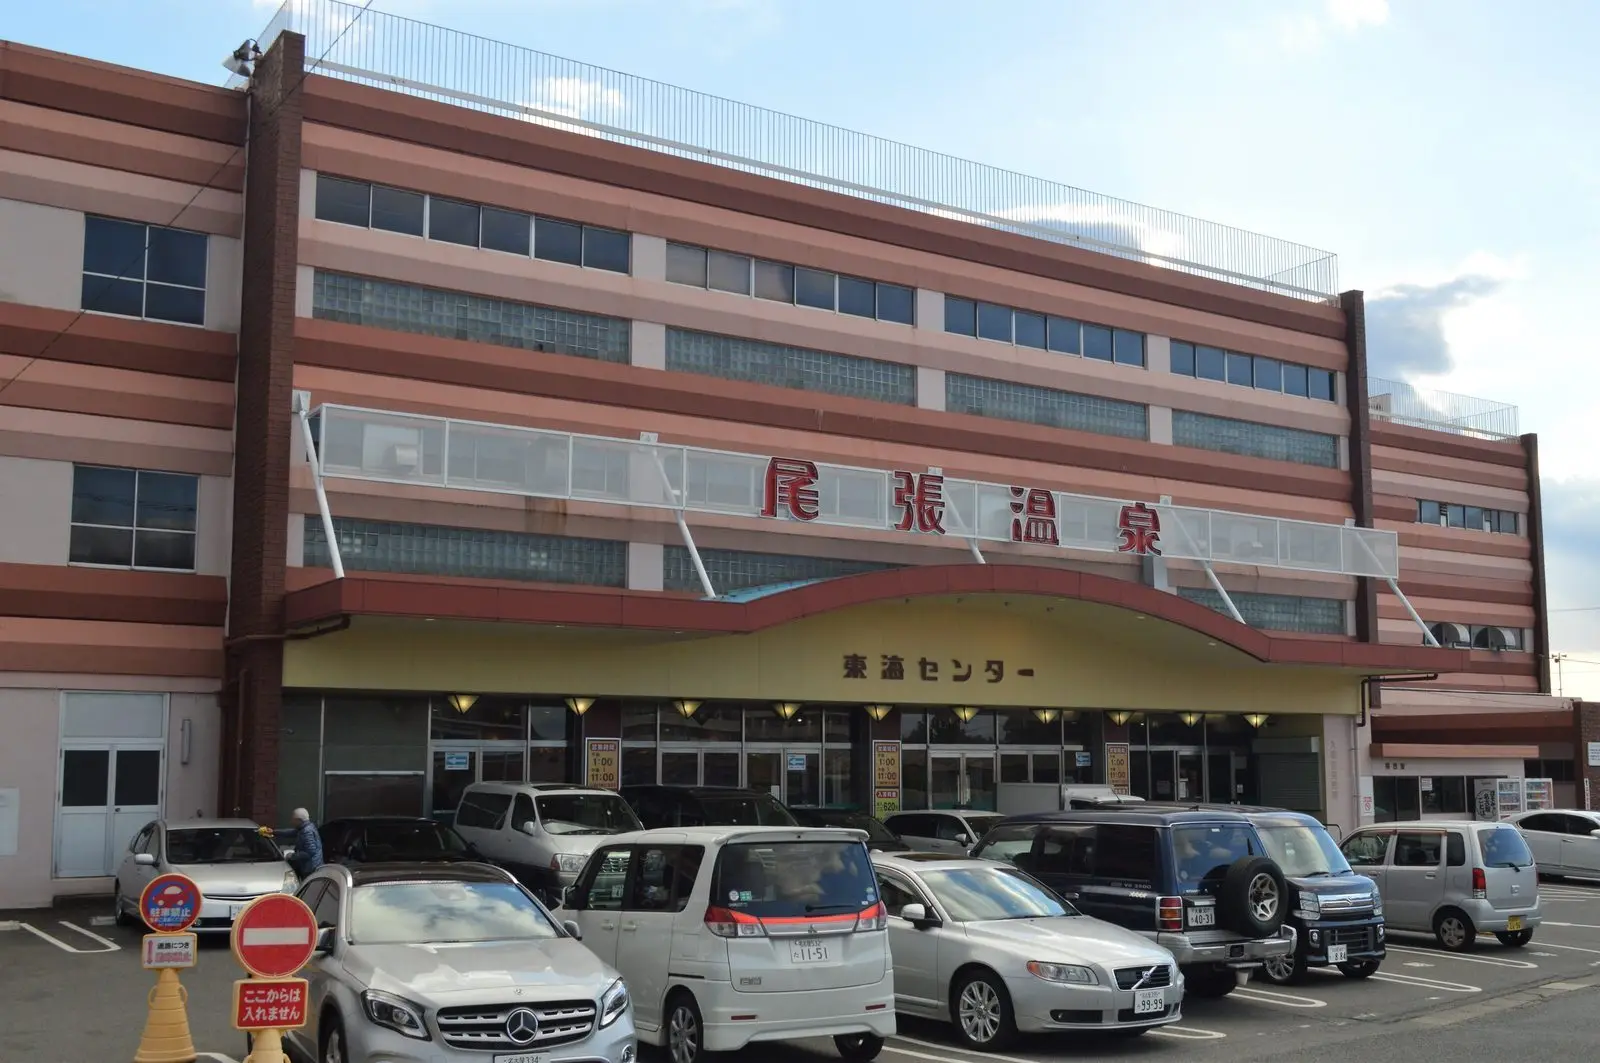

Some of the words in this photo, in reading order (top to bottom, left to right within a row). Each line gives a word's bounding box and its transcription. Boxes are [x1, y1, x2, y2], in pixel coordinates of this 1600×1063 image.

[760, 456, 1162, 557] 尾張温泉
[843, 653, 1035, 683] 東海センター
[593, 758, 612, 766] 1:00
[880, 758, 895, 766] 1:00
[592, 773, 614, 781] 11:00
[878, 772, 896, 780] 11:00
[244, 988, 301, 1003] ここからは
[1141, 998, 1163, 1011] 99-99
[242, 1006, 300, 1021] 入れません
